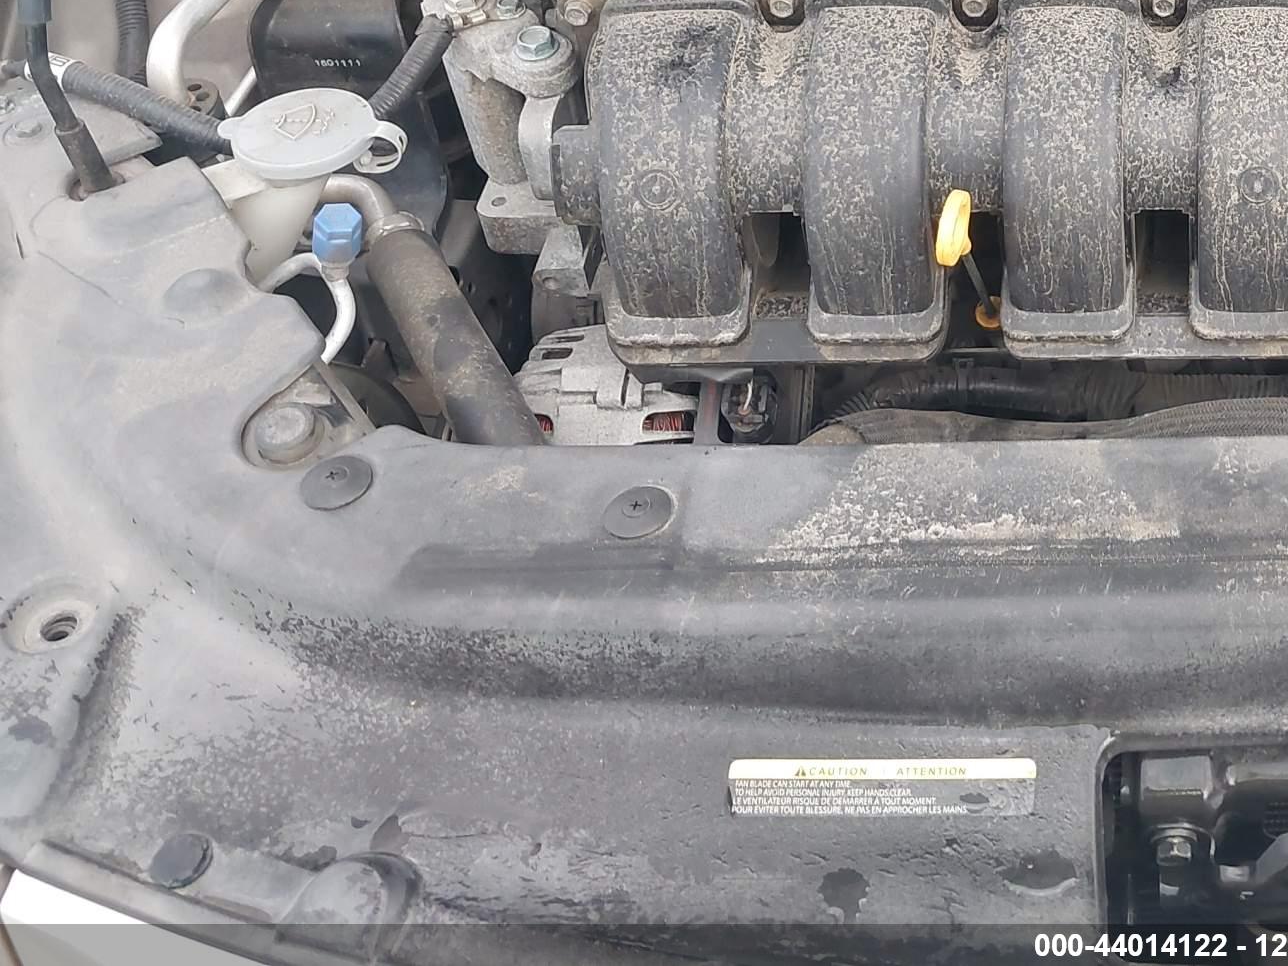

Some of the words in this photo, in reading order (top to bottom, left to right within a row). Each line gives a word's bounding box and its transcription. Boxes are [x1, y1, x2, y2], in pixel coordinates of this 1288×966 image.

[809, 766, 867, 776] CAUTION
[896, 766, 967, 776] ATTENTION
[735, 779, 749, 788] FAN
[750, 779, 771, 788] BLADE
[773, 779, 788, 788] CAN
[788, 779, 809, 788] START
[810, 779, 819, 788] AT
[820, 779, 834, 788] ANY
[735, 788, 745, 796] TO
[745, 788, 763, 797] HELP
[763, 788, 785, 797] AVOID
[786, 788, 820, 797] PERSONAL
[847, 788, 864, 797] KEEP
[864, 788, 889, 797] HANDS
[733, 797, 742, 805] LE
[743, 797, 791, 805] VENTILATEUR
[792, 797, 820, 805] RISQUE
[821, 797, 832, 805] DE
[881, 797, 901, 806] TOUT
[732, 805, 753, 814] POUR
[780, 805, 804, 814] TOUTE
[844, 805, 855, 814] NE
[856, 805, 871, 814] PAS
[872, 805, 882, 814] EN
[883, 805, 928, 815] APPROCHER
[929, 805, 942, 814] LES
